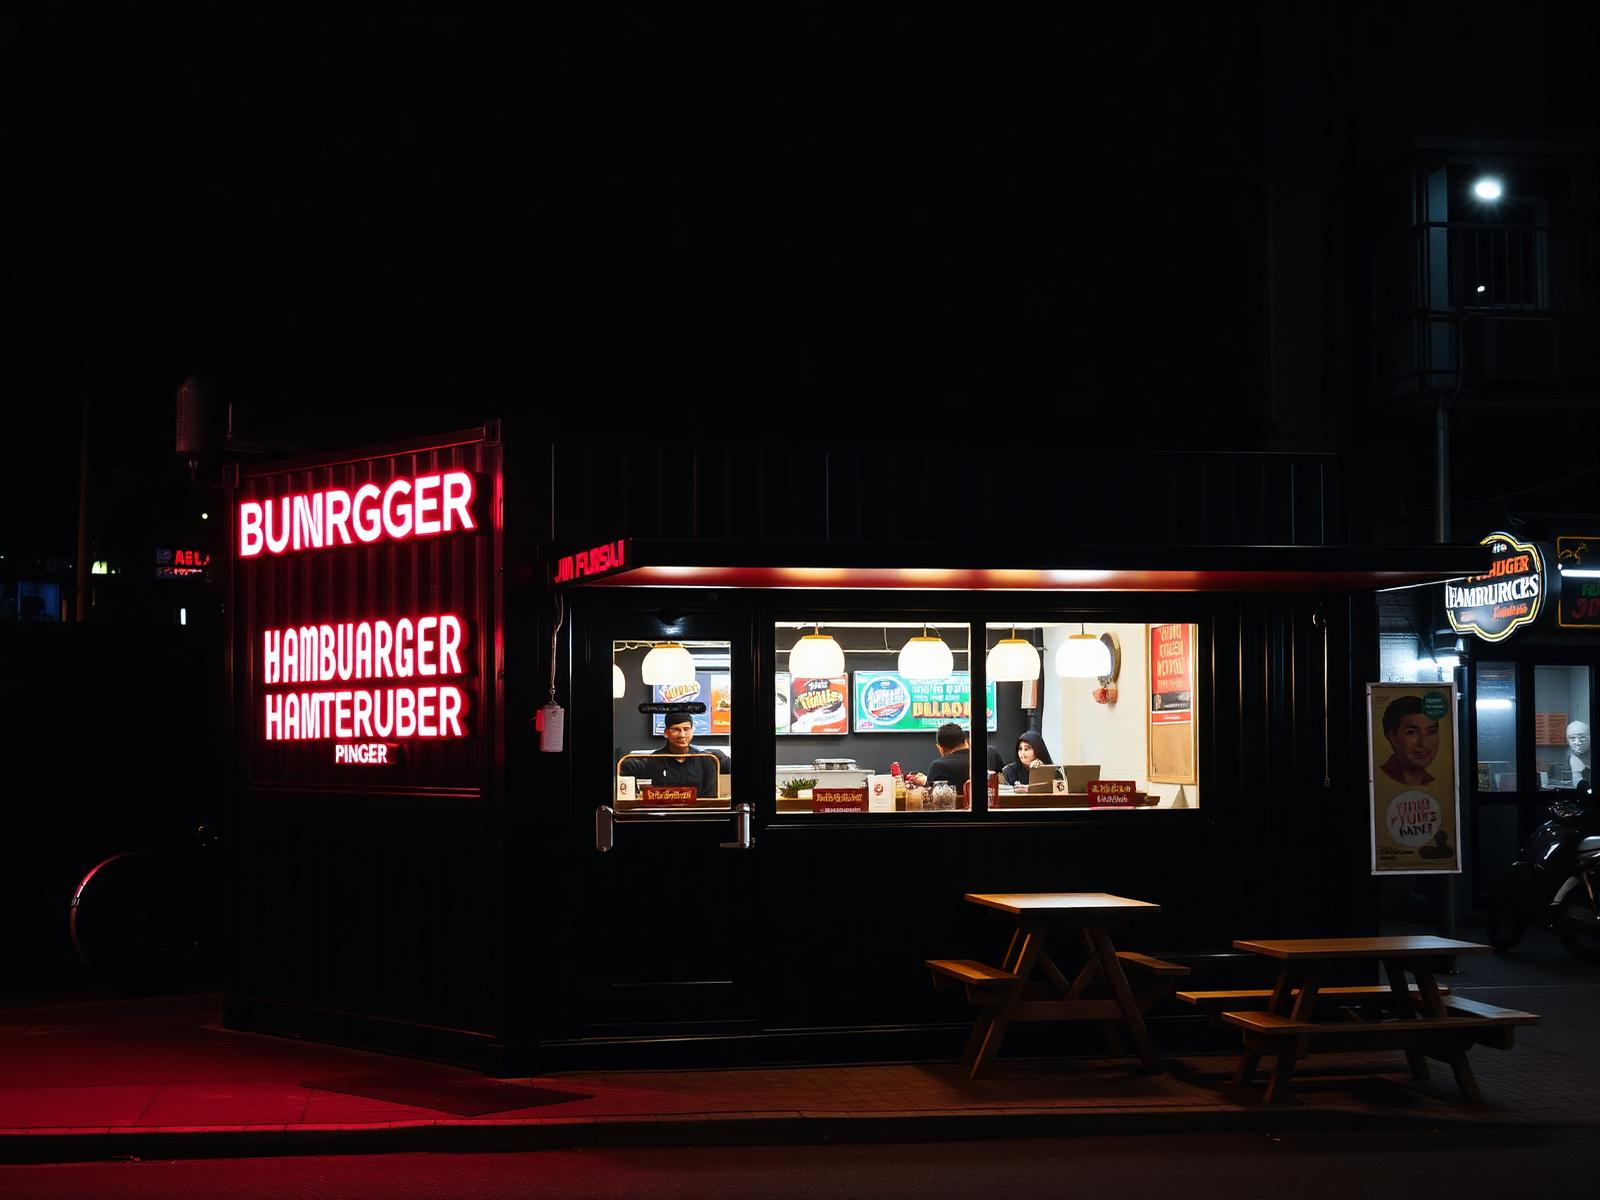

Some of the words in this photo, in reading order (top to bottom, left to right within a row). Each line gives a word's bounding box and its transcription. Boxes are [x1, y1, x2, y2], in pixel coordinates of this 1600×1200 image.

[264, 615, 462, 684] HAMBUARGER
[265, 686, 462, 740] HAMTERUBER
[335, 743, 388, 764] PINGER
